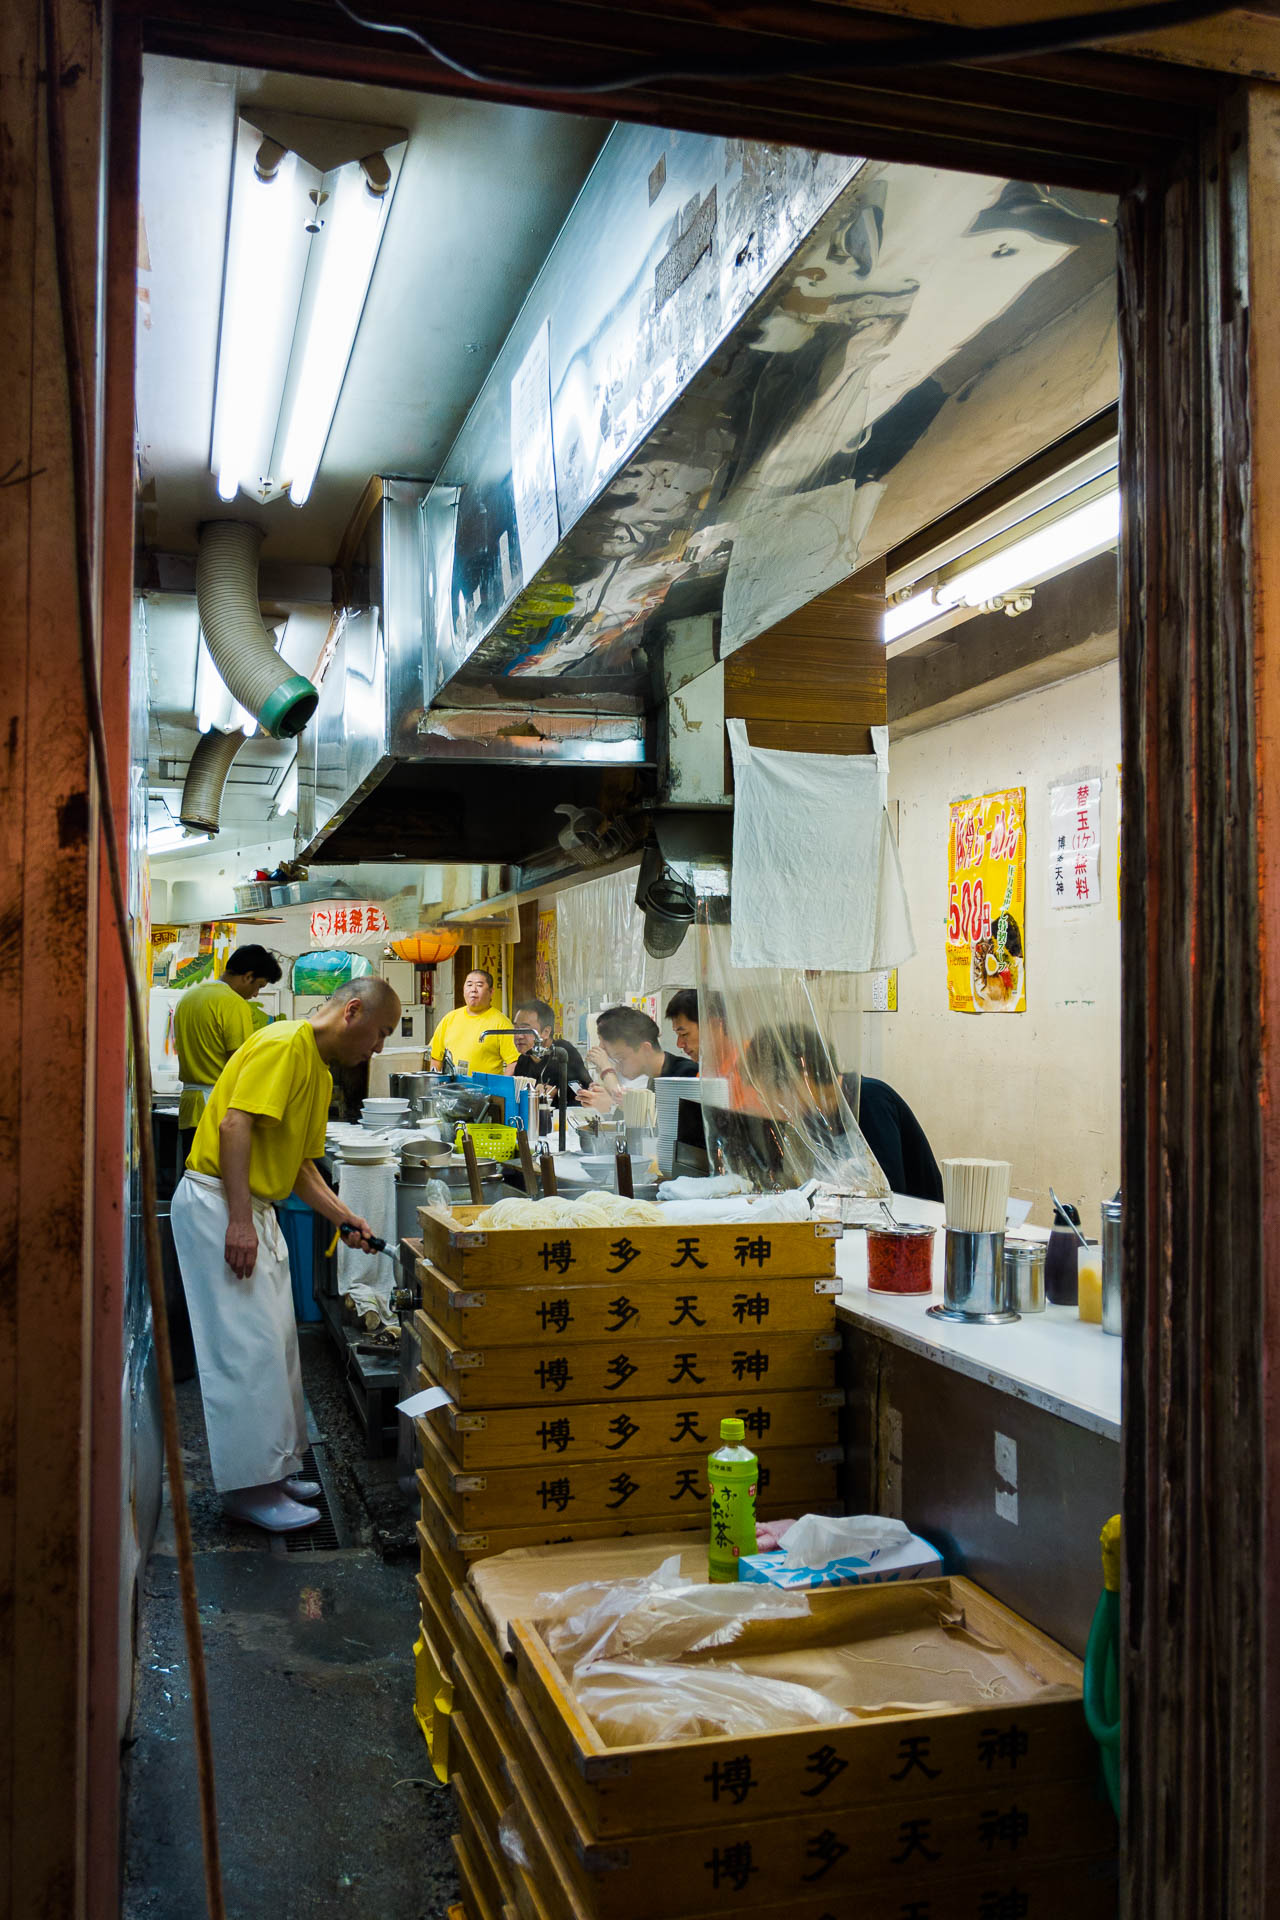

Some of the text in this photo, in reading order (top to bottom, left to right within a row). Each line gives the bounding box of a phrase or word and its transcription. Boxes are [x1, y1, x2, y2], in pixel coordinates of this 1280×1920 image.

[949, 879, 991, 942] 500円
[538, 1236, 772, 1275] 博多天神
[536, 1292, 770, 1334] 博多天神
[535, 1350, 769, 1393] 博多天神
[704, 1723, 1030, 1806] 博多天神
[704, 1804, 1030, 1892] 博多天神
